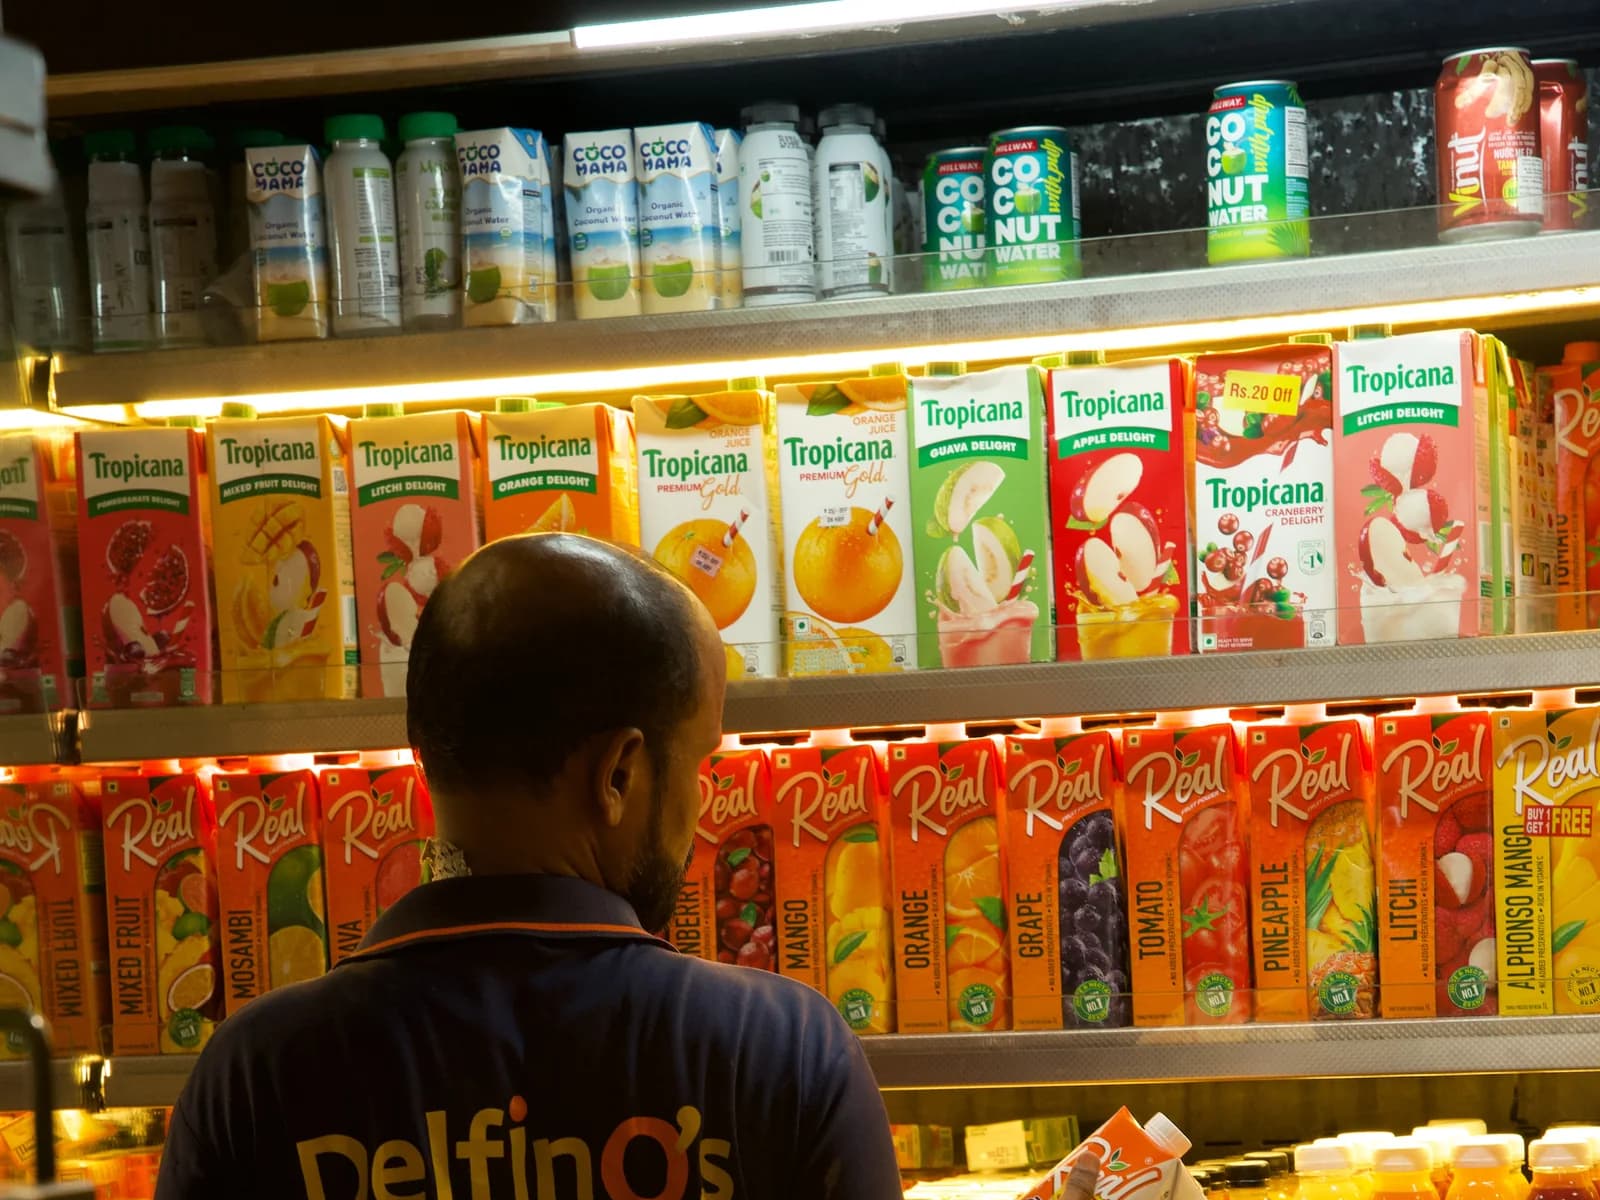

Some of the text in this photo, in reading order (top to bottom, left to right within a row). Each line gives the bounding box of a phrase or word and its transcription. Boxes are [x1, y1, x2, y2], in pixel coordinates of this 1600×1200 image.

[573, 143, 626, 162] COCO
[640, 138, 689, 157] COCO
[576, 160, 627, 176] MAMA
[643, 156, 691, 171] MAMA
[1208, 175, 1268, 208] NUT
[995, 215, 1062, 244] NUT
[1208, 204, 1268, 227] WATER
[939, 235, 984, 262] NU
[996, 243, 1061, 263] WATER
[1230, 382, 1293, 403] Rs.20 Off
[1346, 364, 1454, 397] Tropicana
[921, 399, 1023, 430] Tropicana
[1060, 389, 1164, 421] Tropicana
[1357, 408, 1444, 427] LITCHI DELIGHT
[710, 427, 752, 439] ORANGE
[852, 414, 896, 427] ORANGE
[869, 423, 896, 435] JUICE
[220, 438, 316, 468] Tropicana
[359, 440, 453, 470] Tropicana
[494, 434, 592, 464] Tropicana
[724, 438, 752, 448] JUICE
[783, 436, 893, 470] Tropicana
[929, 440, 1017, 459] GUAVA DELIGHT
[1073, 431, 1156, 450] APPLE DELIGHT
[88, 452, 185, 482] Tropicana
[642, 448, 749, 481] Tropicana
[222, 478, 319, 498] MIXED FRUIT DELIGHT
[371, 480, 447, 498] LITCHI DELIGHT
[498, 475, 591, 493] ORANGE DELIGHT
[657, 474, 741, 511] PREMIUM Gold
[799, 462, 888, 499] PREMIUM Gold
[1205, 477, 1324, 512] Tropicana
[1265, 506, 1325, 518] CRANBERRY
[1280, 514, 1325, 525] DELIGHT
[1127, 735, 1227, 830] Real
[1252, 732, 1351, 828] Real
[1382, 723, 1485, 819] Real
[776, 757, 868, 848] Real
[893, 750, 989, 842] Real
[1009, 744, 1105, 838] Real
[107, 785, 195, 872] Real
[219, 781, 306, 870] Real
[328, 776, 415, 864] Real
[1526, 821, 1550, 834] GET 1
[1527, 807, 1551, 820] BUY 1
[1552, 807, 1590, 834] FREE
[1502, 823, 1534, 890] MANGO
[1135, 880, 1167, 961] TOMATO
[1261, 861, 1289, 973] PINEAPPLE
[1390, 878, 1418, 942] LITCHI
[784, 898, 809, 970] MANGO
[902, 889, 930, 969] ORANGE
[1016, 892, 1044, 959] GRAPE
[114, 895, 145, 1018] MIXED FRUIT
[228, 909, 255, 1000] MOSAMBI
[1504, 894, 1536, 991] ALPHONSO
[1461, 984, 1479, 1000] NO.1
